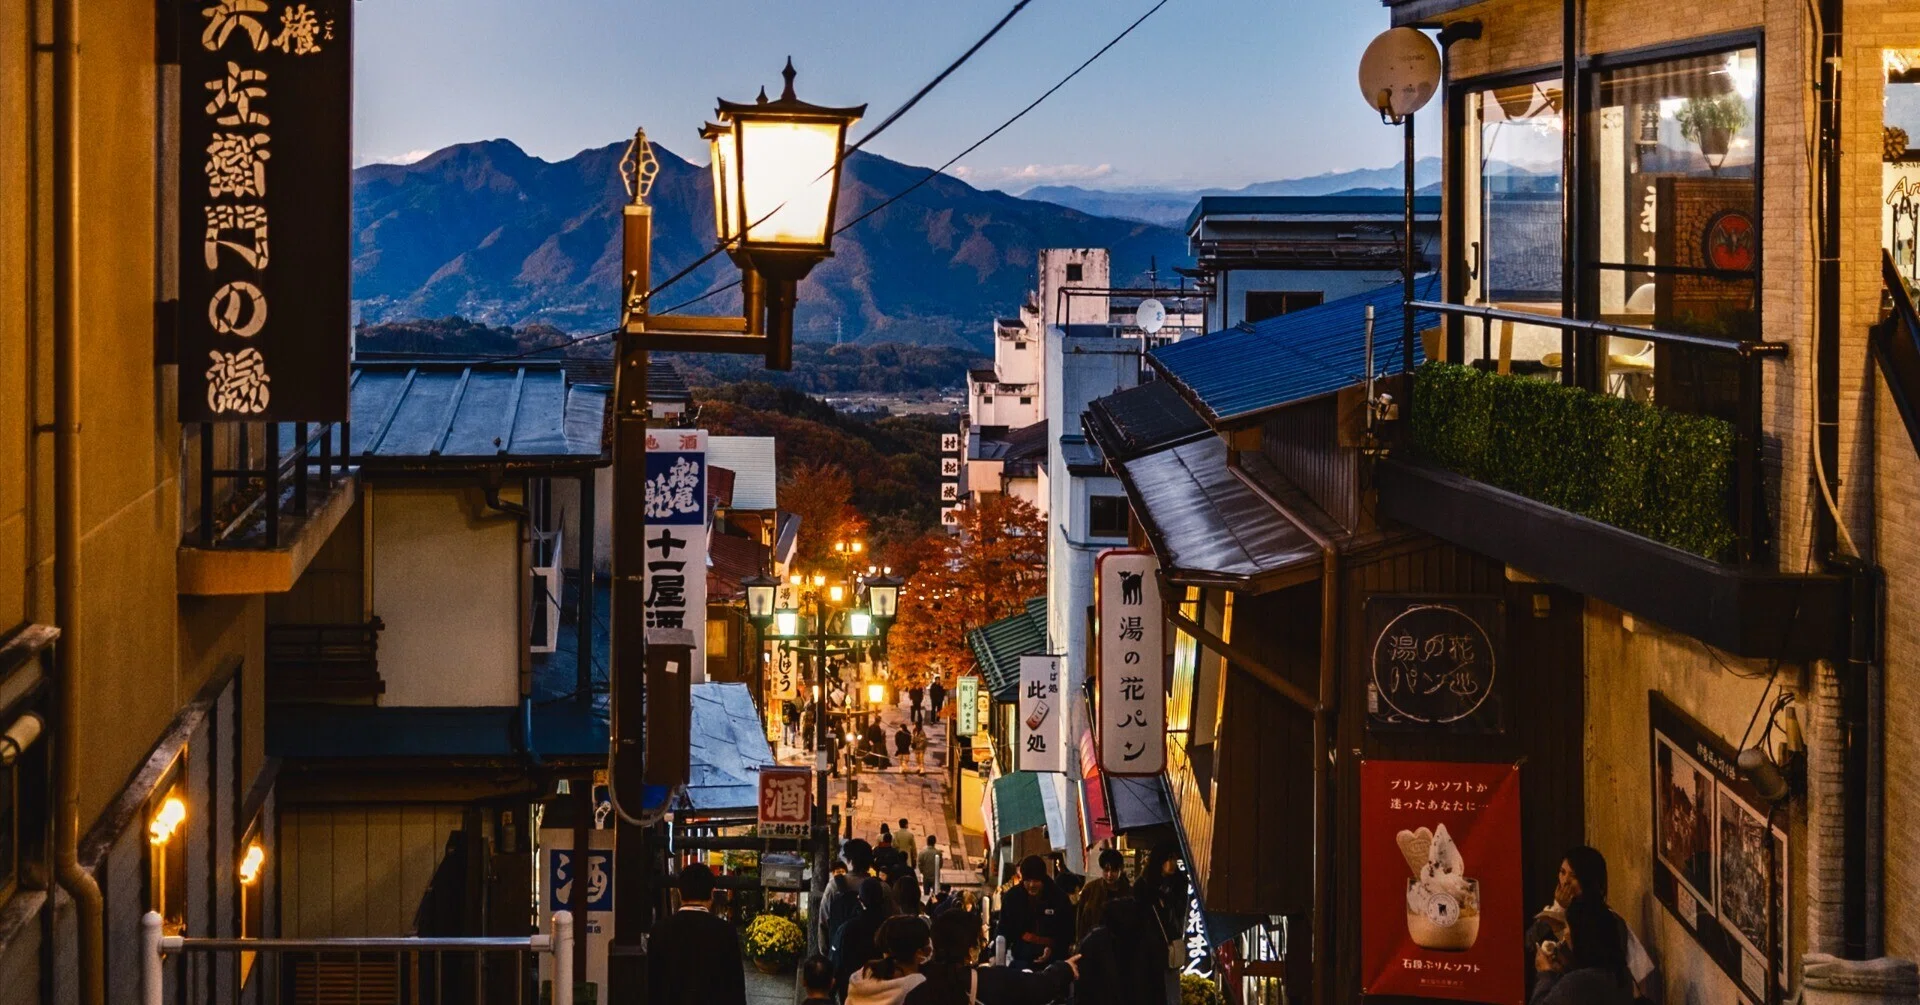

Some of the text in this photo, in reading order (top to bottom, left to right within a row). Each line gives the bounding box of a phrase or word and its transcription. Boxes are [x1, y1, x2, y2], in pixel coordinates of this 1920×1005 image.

[1388, 633, 1476, 663] 湯の花
[1048, 661, 1059, 694] そば処
[1117, 616, 1148, 762] 湯の花パン
[1390, 666, 1446, 695] パン
[765, 776, 807, 820] 酒
[1390, 779, 1488, 794] プリンかソフトか
